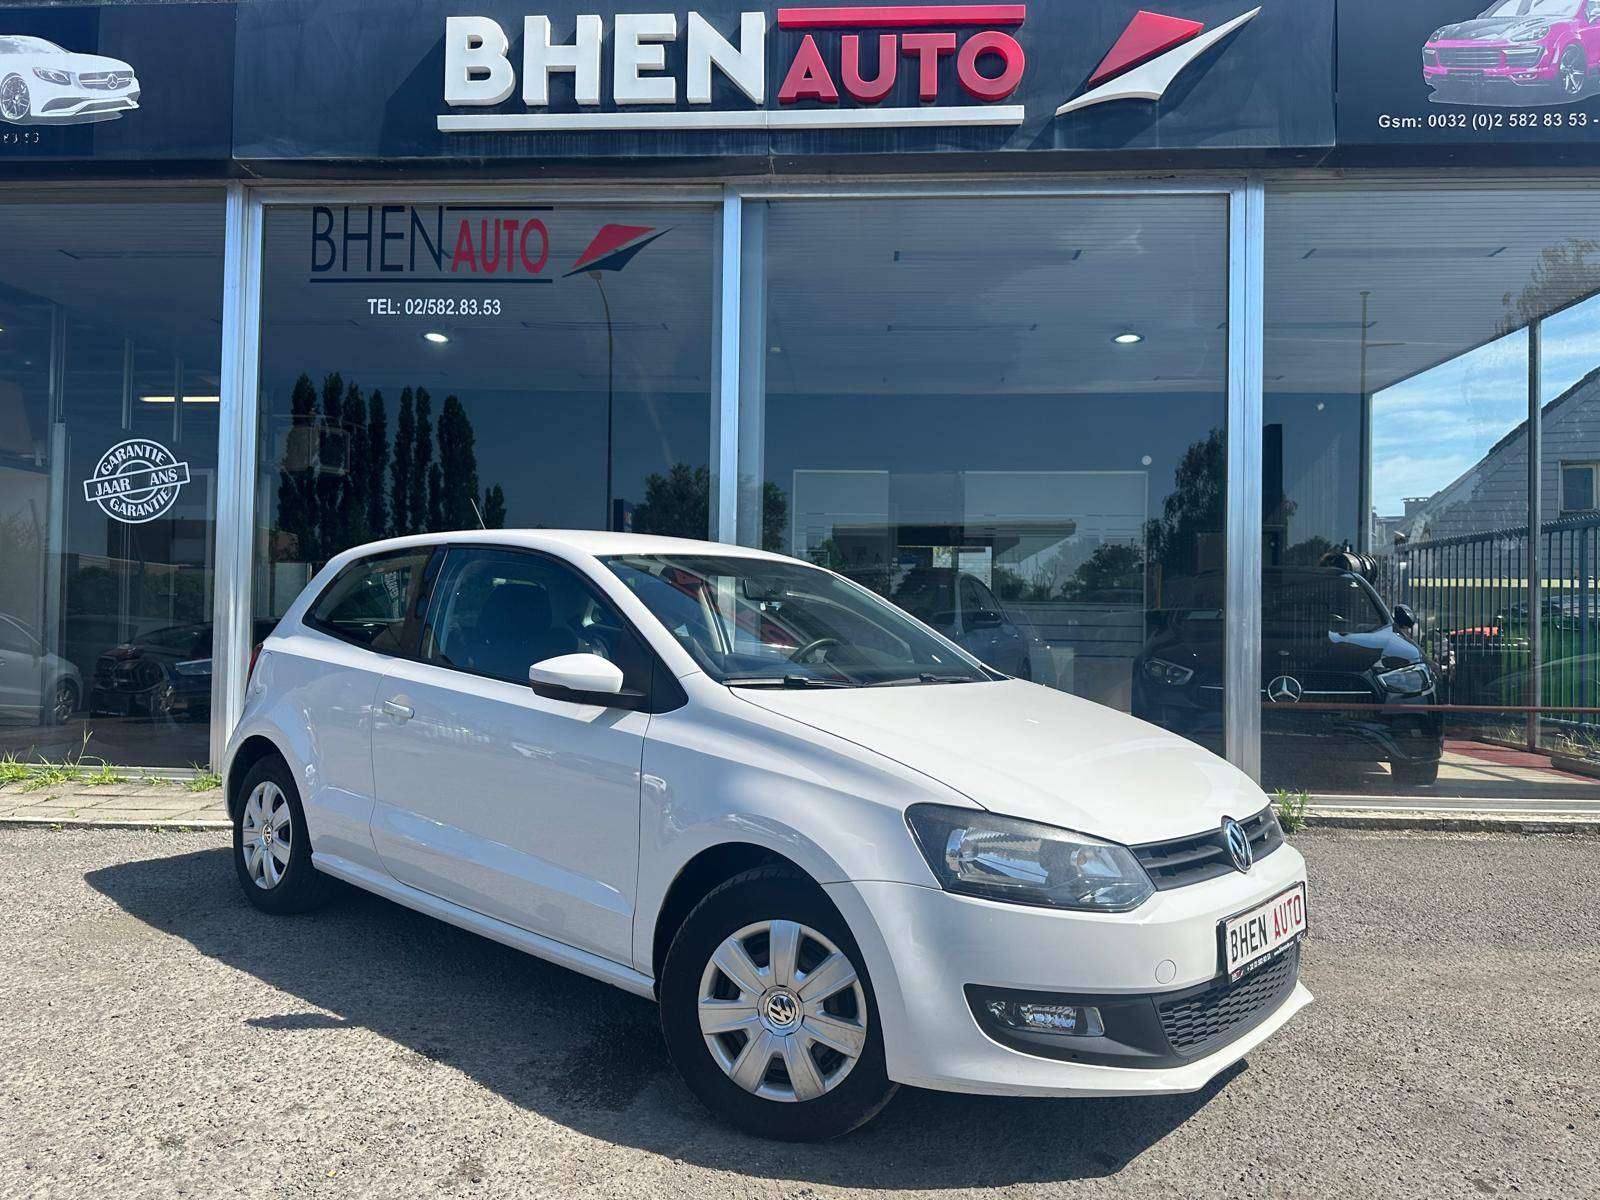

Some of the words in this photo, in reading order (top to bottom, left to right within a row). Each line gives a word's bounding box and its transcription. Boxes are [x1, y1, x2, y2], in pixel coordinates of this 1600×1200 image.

[444, 12, 766, 106] BHEN
[777, 30, 1026, 104] AUTO
[1378, 114, 1422, 129] Gsm:
[1428, 114, 1467, 128] 0032
[1472, 113, 1503, 131] (0)2
[1508, 113, 1538, 127] 582
[1543, 113, 1562, 127] 83
[1568, 113, 1587, 126] 53
[310, 205, 446, 273] BHEN
[451, 217, 549, 275] AUTO
[367, 298, 401, 315] TEL:
[405, 298, 502, 315] 02/582.83.53
[100, 444, 167, 475] GARANTIE
[95, 477, 131, 496] JAAR
[150, 468, 178, 486] ANS
[109, 487, 172, 517] GARANTIE
[1230, 913, 1268, 963] BHEN
[1273, 894, 1303, 940] AUTO
